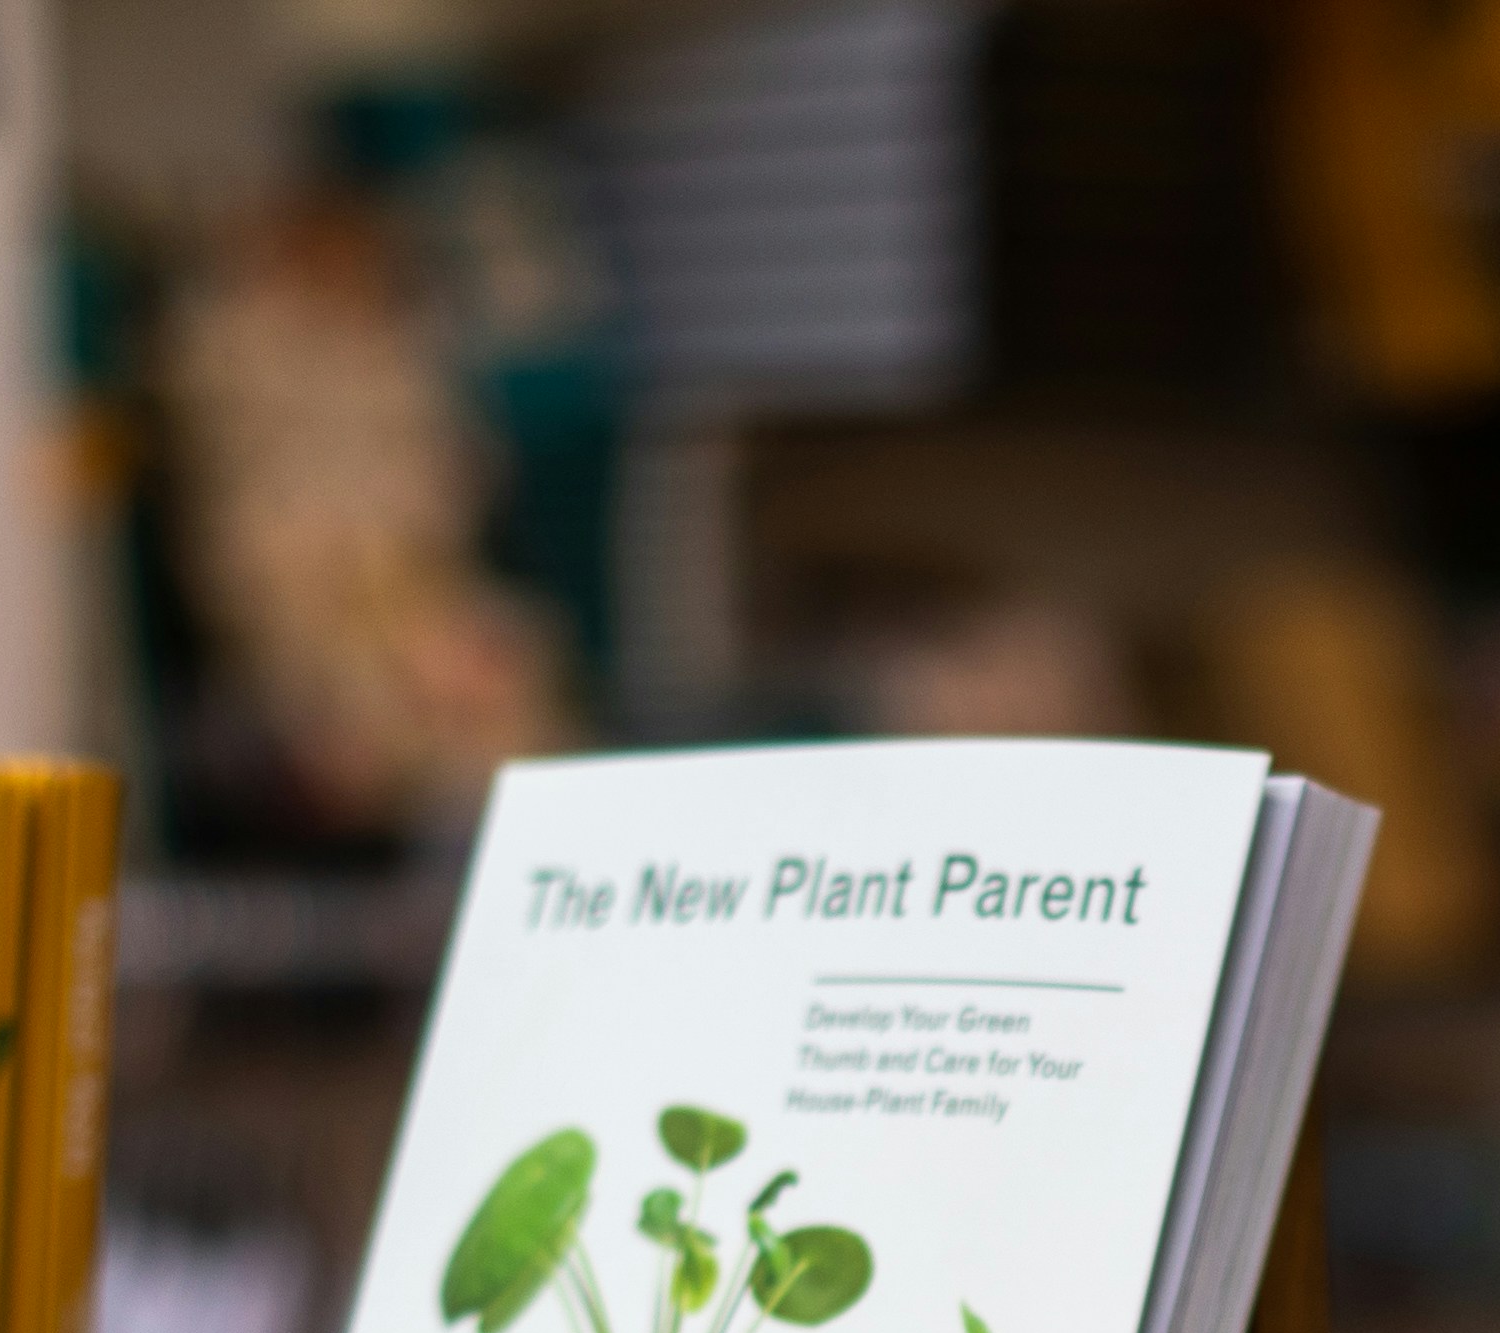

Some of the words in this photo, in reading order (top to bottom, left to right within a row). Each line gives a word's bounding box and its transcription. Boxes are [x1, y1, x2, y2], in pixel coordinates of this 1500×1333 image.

[524, 866, 613, 933] The
[627, 862, 747, 930] New
[764, 856, 914, 920] Plant
[931, 853, 1149, 927] Parent
[804, 1003, 895, 1035] Develop
[901, 1005, 953, 1032] Your
[955, 1006, 1031, 1036] Green
[796, 1045, 870, 1073] Thumb
[878, 1047, 919, 1075] and
[925, 1049, 981, 1076] Care
[988, 1050, 1021, 1078] for
[1026, 1052, 1084, 1081] Your
[930, 1090, 1010, 1124] Family
